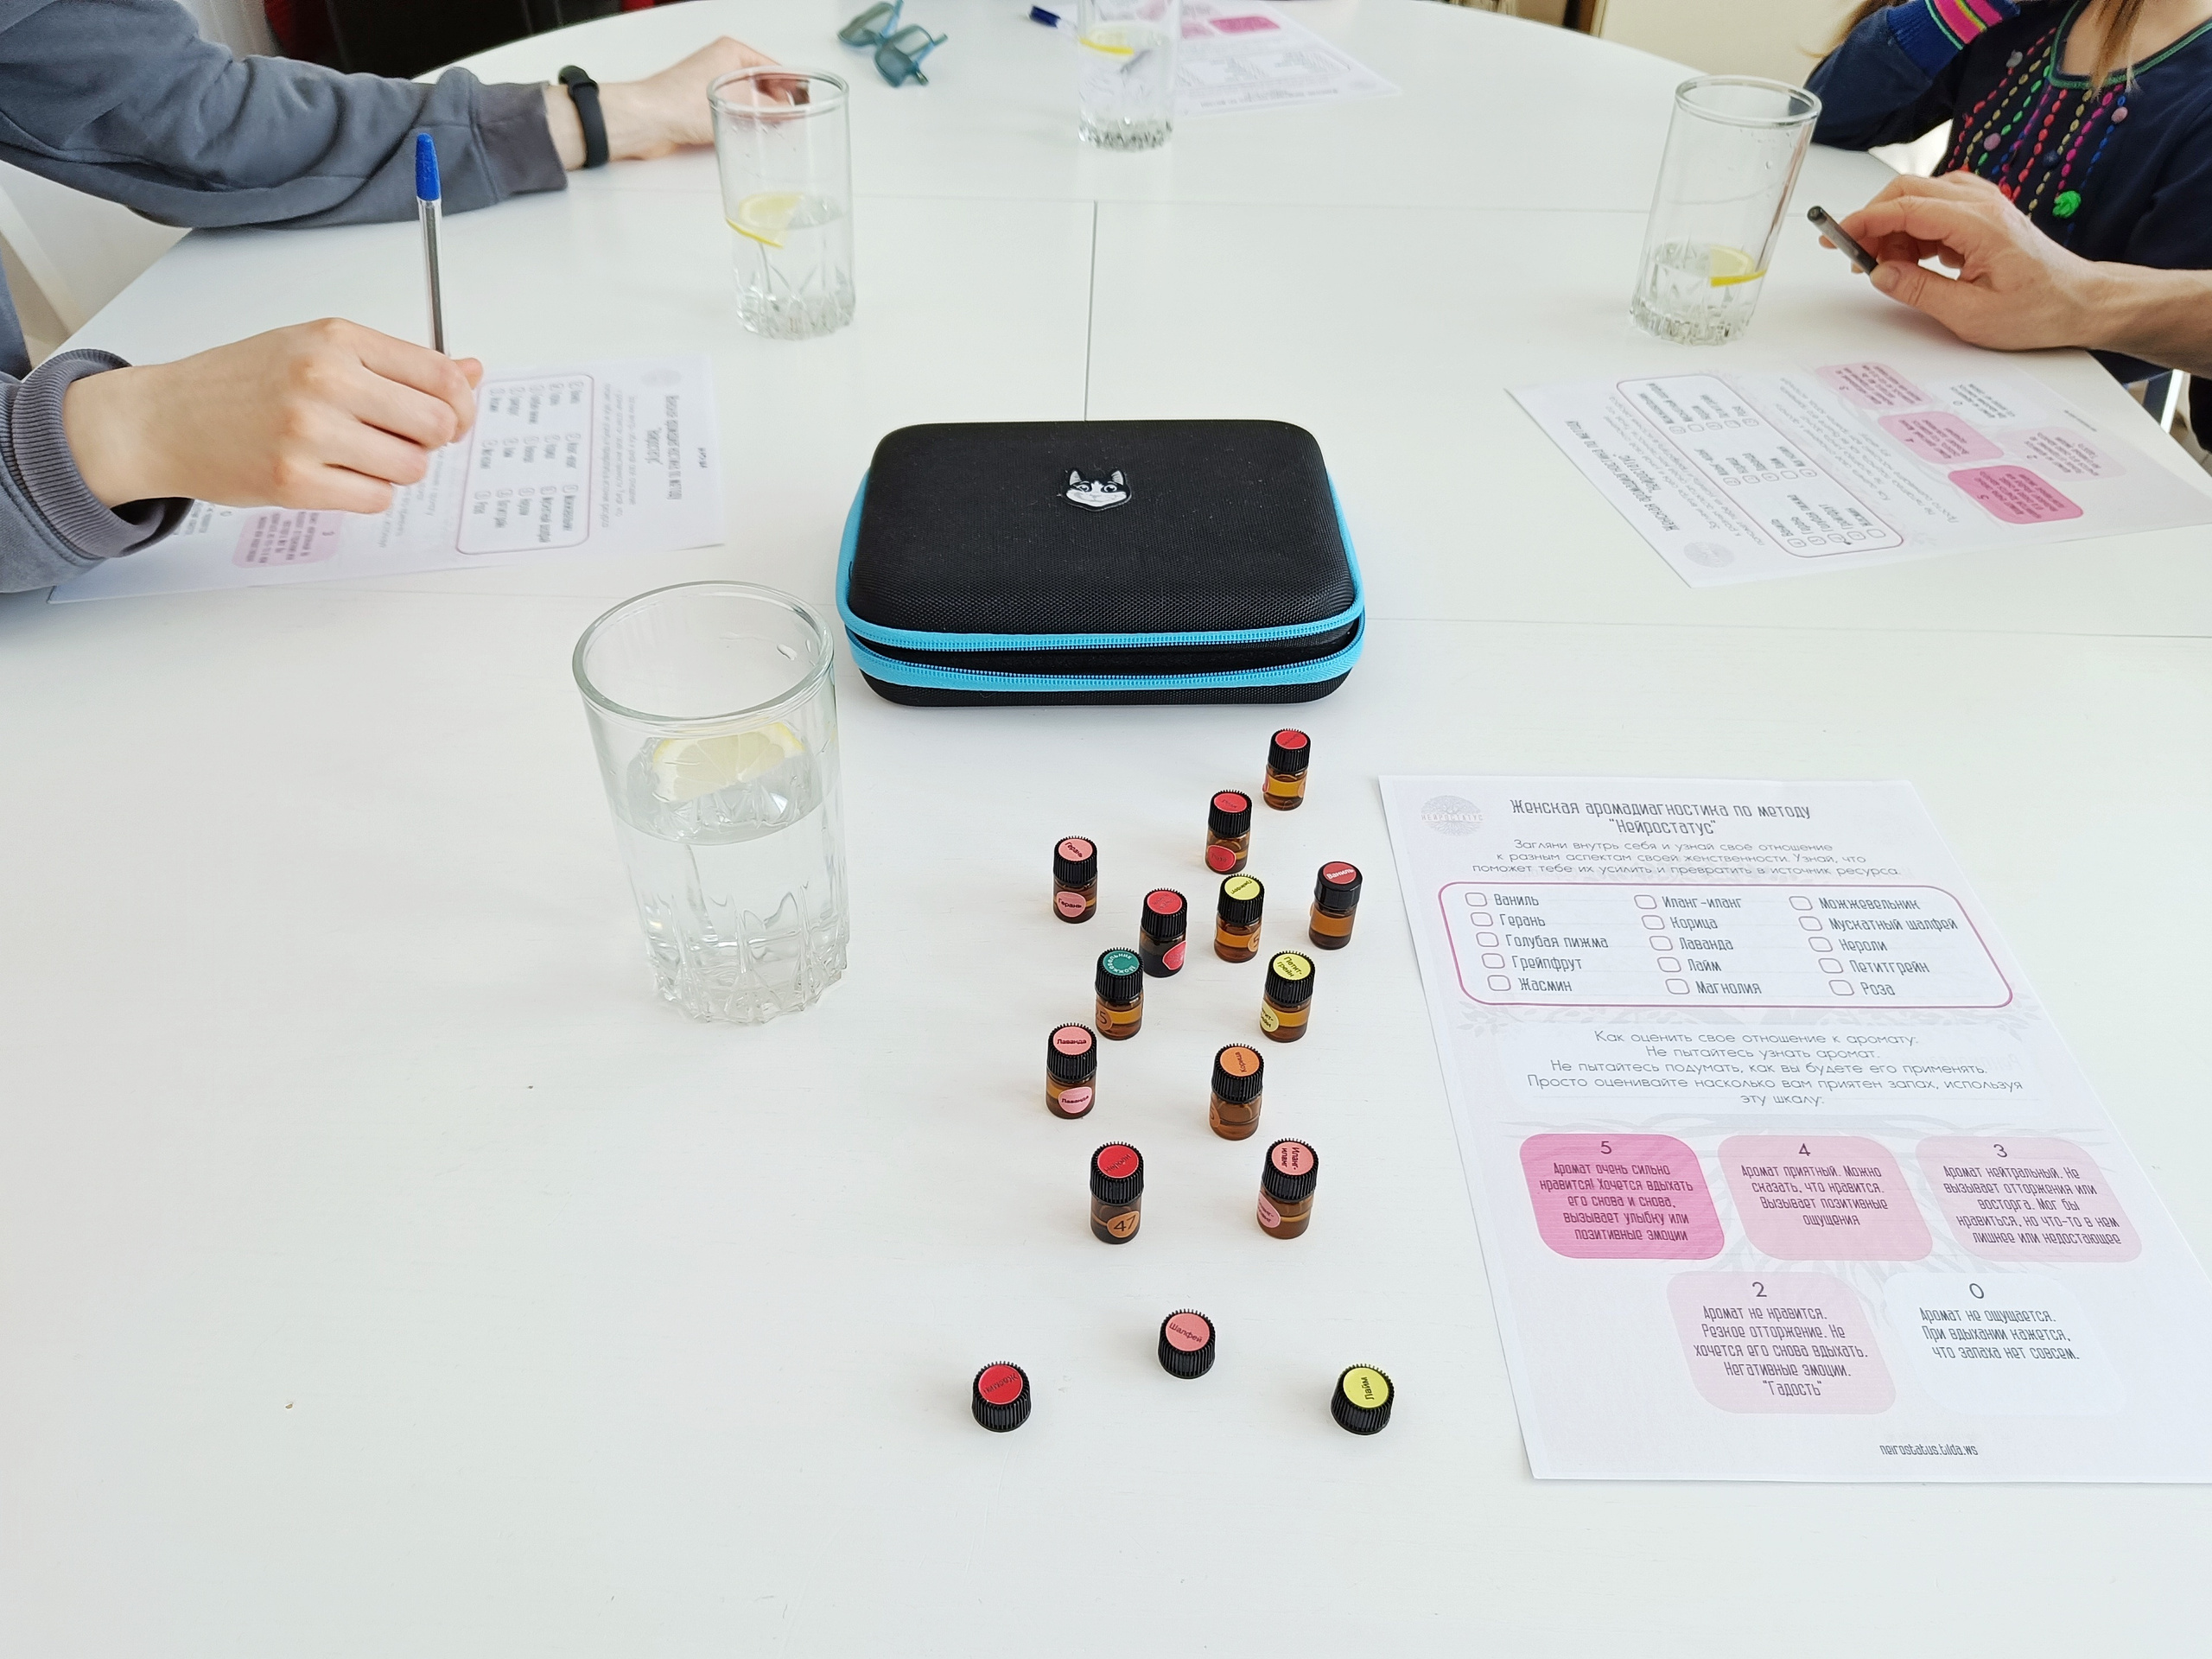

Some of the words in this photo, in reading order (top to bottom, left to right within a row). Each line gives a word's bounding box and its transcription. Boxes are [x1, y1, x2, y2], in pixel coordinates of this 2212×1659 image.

[1509, 798, 1580, 815] Женская
[1584, 802, 1730, 818] аромадиагностика
[1732, 804, 1753, 817] по
[1756, 805, 1811, 820] методу
[1065, 842, 1084, 858] Герань
[1513, 838, 1568, 849] Загляни
[1572, 842, 1620, 852] внутрь
[1623, 840, 1657, 850] себя
[1674, 842, 1715, 853] узнай
[1758, 843, 1834, 852] отношение
[1508, 853, 1561, 863] разным
[1565, 853, 1632, 861] аспектам
[1636, 854, 1680, 862] своей
[1325, 868, 1355, 880] Ваниль
[1471, 864, 1533, 873] поможет
[1537, 862, 1573, 874] тебе
[1598, 865, 1653, 875] усилить
[1669, 866, 1753, 876] превратить
[1769, 867, 1832, 875] источник
[1492, 893, 1540, 906] Ваниль
[1661, 895, 1742, 909] Иланг-иланг
[1817, 896, 1921, 910] Можжевельник
[1498, 912, 1547, 930] Герань
[1669, 916, 1719, 932] Корица
[1827, 917, 1904, 932] Мускатный
[1904, 917, 1959, 933] шалфей
[1504, 933, 1560, 950] Голубая
[1562, 937, 1610, 949] пижма
[1678, 936, 1734, 951] Лаванда
[1837, 938, 1889, 954] Нероли
[1510, 954, 1582, 973] Грейпфрут
[1687, 957, 1722, 972] Лайм
[1848, 958, 1930, 976] Петитгрейн
[1517, 976, 1573, 992] Жасмин
[1694, 980, 1763, 995] Магнолия
[1859, 981, 1897, 996] Роза
[1593, 1029, 1625, 1042] Как
[1630, 1033, 1694, 1043] оценить
[1697, 1033, 1736, 1043] свое
[1741, 1033, 1827, 1044] отношение
[1644, 1045, 1668, 1058] Не
[1672, 1047, 1755, 1058] пытайтесь
[1758, 1049, 1811, 1061] узнать
[1234, 1051, 1248, 1074] Корица
[1549, 1058, 1573, 1072] Не
[1577, 1062, 1660, 1072] пытайтесь
[1747, 1064, 1776, 1073] как
[1804, 1061, 1863, 1077] будете
[1868, 1064, 1897, 1074] его
[1526, 1073, 1588, 1090] Просто
[1593, 1077, 1688, 1088] оценивайте
[1693, 1078, 1777, 1089] насколько
[1816, 1079, 1884, 1092] приятен
[1942, 1079, 2024, 1093] используя
[1599, 1140, 1613, 1155] 5
[1797, 1142, 1811, 1157] 4
[1993, 1143, 2008, 1158] 3
[1553, 1161, 1592, 1178] Аромат
[1594, 1163, 1630, 1175] очень
[1630, 1164, 1671, 1176] сильно
[1740, 1164, 1780, 1179] Аромат
[1841, 1164, 1883, 1178] Можно
[1942, 1165, 1983, 1180] Аромат
[1595, 1177, 1643, 1191] Хочется
[1644, 1179, 1694, 1192] вдыхать
[1803, 1181, 1827, 1193] что
[1942, 1182, 2000, 1194] вызывает
[2002, 1182, 2075, 1197] отторжения
[2073, 1184, 2098, 1195] или
[1567, 1195, 1589, 1207] его
[1590, 1195, 1625, 1207] снова
[1758, 1195, 1816, 1210] Вызывает
[1819, 1198, 1889, 1210] позитивные
[2034, 1197, 2057, 1211] Мог
[1112, 1213, 1136, 1233] 47
[1561, 1211, 1620, 1224] вызывает
[1622, 1210, 1665, 1226] улыбку
[1667, 1212, 1690, 1224] или
[1802, 1214, 1861, 1228] ощущения
[2039, 1215, 2083, 1228] что-то
[2094, 1216, 2120, 1228] нем
[1573, 1228, 1643, 1241] позитивные
[1645, 1229, 1689, 1243] эмоции
[1971, 1231, 2017, 1243] лишнее
[2016, 1231, 2042, 1244] или
[2041, 1232, 2122, 1246] недостающее
[1751, 1281, 1768, 1298] 2
[1968, 1282, 1985, 1300] 0
[1702, 1305, 1745, 1322] Аромат
[1918, 1306, 1962, 1325] Аромат
[1168, 1321, 1203, 1344] Шалфей
[1700, 1322, 1746, 1338] Резкое
[1921, 1325, 1948, 1344] При
[1947, 1327, 2009, 1342] вдыхании
[1692, 1344, 1745, 1357] хочется
[1745, 1344, 1770, 1357] его
[1771, 1344, 1810, 1357] снова
[1930, 1345, 1956, 1359] что
[1957, 1345, 2003, 1359] запаха
[1722, 1361, 1799, 1376] Негативные
[1359, 1376, 1375, 1402] Лайм
[1878, 1443, 1980, 1456] neirostatus.tilda.ws
